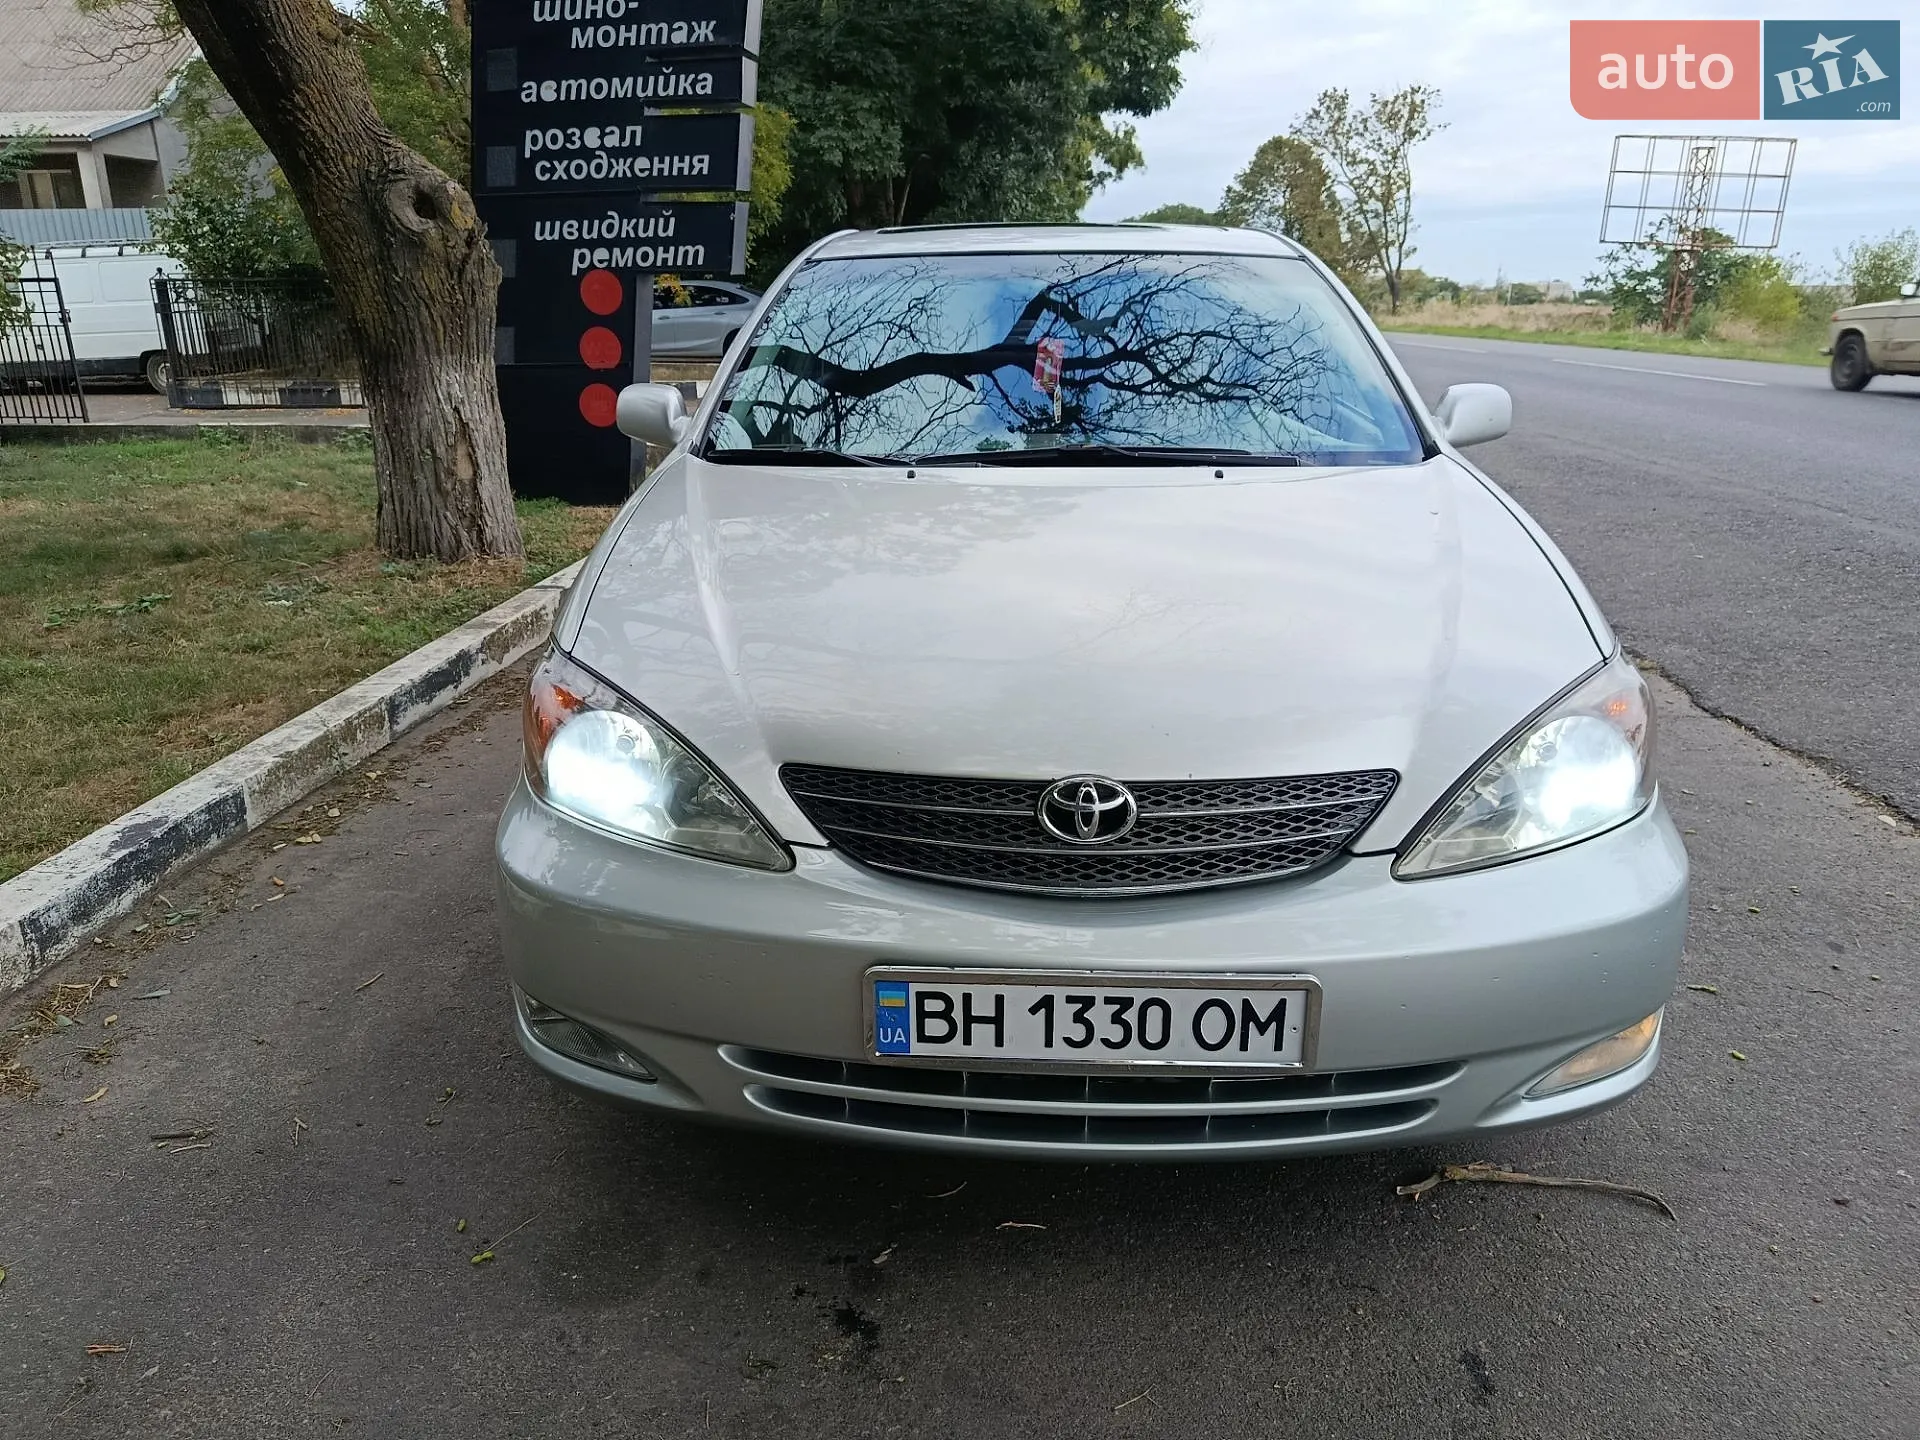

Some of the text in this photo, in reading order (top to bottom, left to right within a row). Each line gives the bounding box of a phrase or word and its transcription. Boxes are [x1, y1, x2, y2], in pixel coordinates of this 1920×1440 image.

[533, 0, 639, 22] шино-
[571, 20, 716, 49] монтаж
[520, 66, 713, 103] автомийка
[524, 125, 642, 158] розвал
[534, 150, 710, 181] сходження
[534, 210, 676, 241] швидкий
[571, 244, 705, 276] ремонт
[880, 1027, 906, 1044] UA
[915, 990, 1288, 1052] BH 1330 OM
